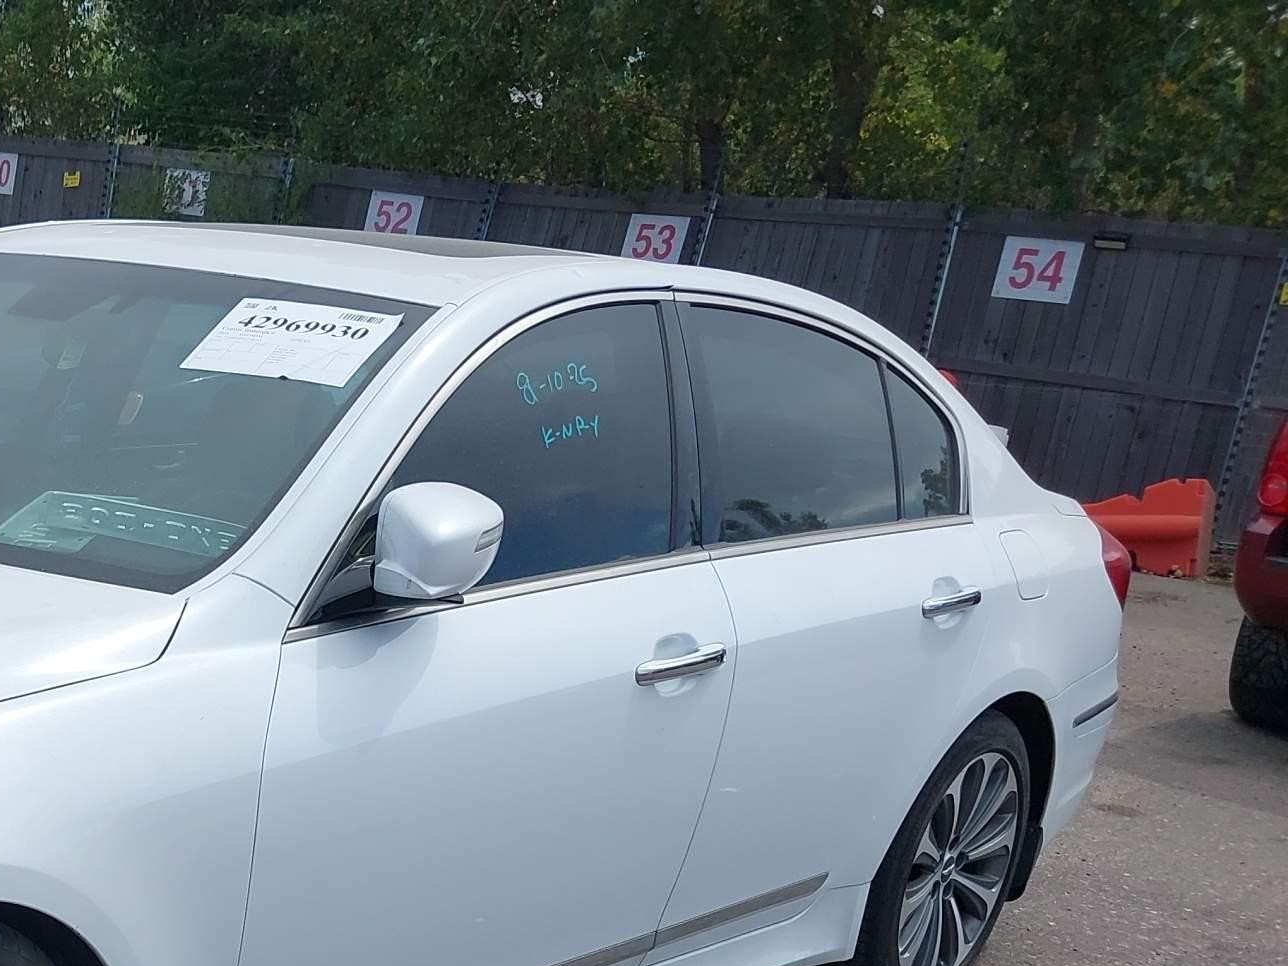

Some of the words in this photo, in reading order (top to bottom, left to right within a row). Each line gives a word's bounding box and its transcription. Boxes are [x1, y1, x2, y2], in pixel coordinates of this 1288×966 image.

[374, 199, 413, 234] 52
[631, 223, 676, 260] 53
[1008, 247, 1067, 292] 54
[238, 314, 370, 341] 42969930
